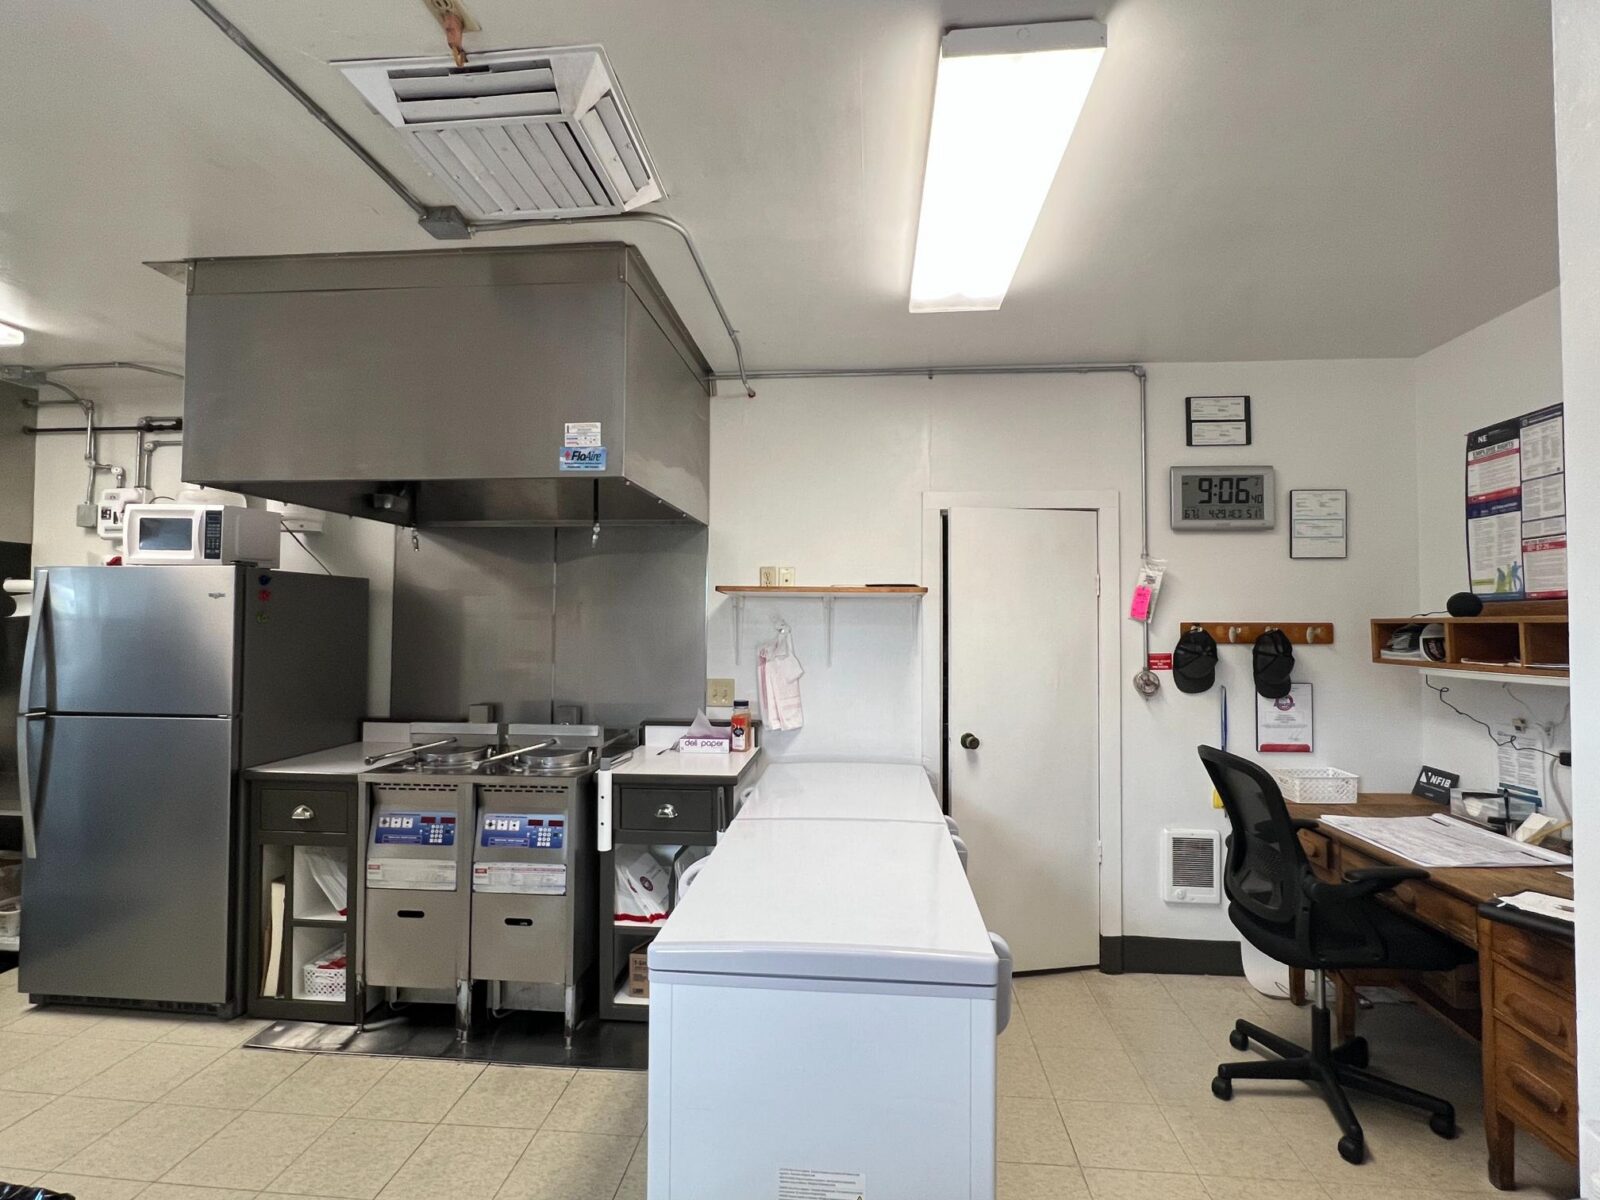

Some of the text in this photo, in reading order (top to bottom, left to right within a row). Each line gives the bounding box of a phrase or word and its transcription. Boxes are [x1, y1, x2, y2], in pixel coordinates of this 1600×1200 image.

[1198, 477, 1250, 504] 9:06
[684, 739, 724, 748] deli paper
[1429, 774, 1452, 788] NFIB
